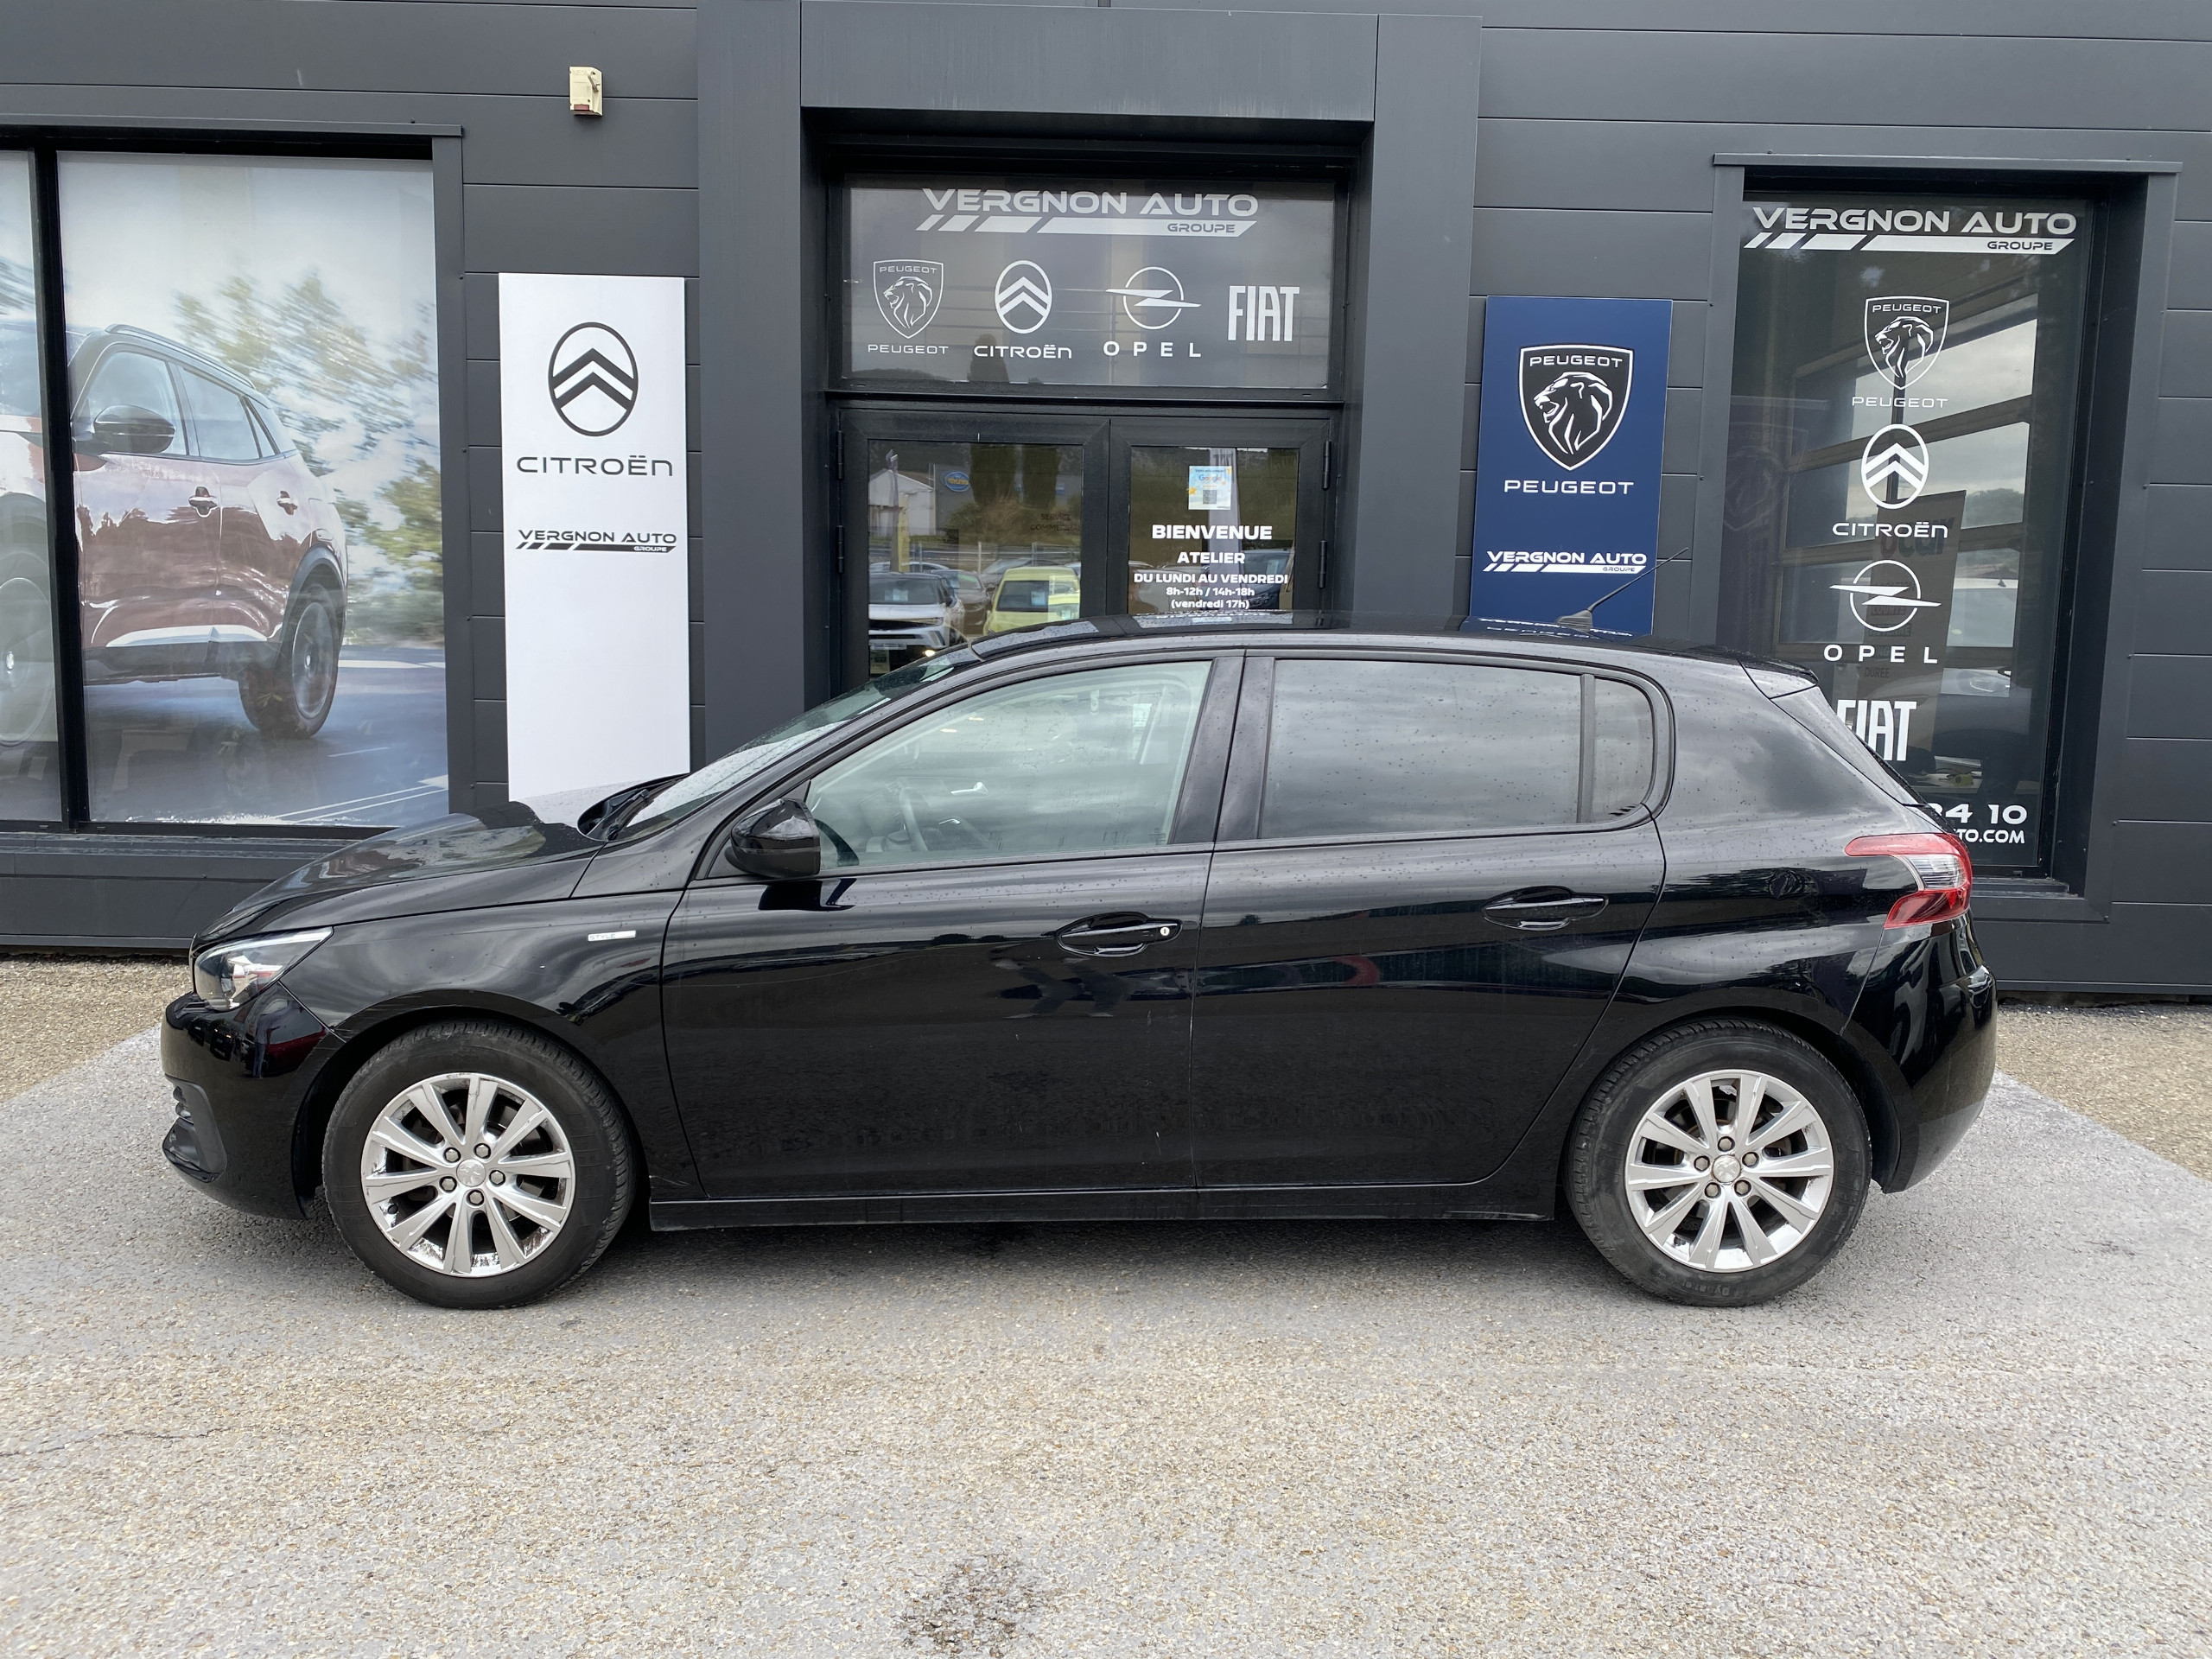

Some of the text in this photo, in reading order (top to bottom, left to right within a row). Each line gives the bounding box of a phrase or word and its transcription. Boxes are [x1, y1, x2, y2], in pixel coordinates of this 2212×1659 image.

[922, 188, 1259, 217] VERGNON AUTO
[1166, 223, 1236, 233] GROUPE
[1752, 207, 2077, 235] VERGNON AUTO
[1986, 240, 2053, 251] GROUPE
[879, 265, 938, 275] PEUGEOT
[1227, 285, 1300, 342] FIAT
[1872, 303, 1942, 314] PEUGEOT
[868, 344, 949, 354] PEUGEOT
[973, 344, 1072, 359] CITROËN
[1103, 340, 1202, 358] OPEL
[1529, 354, 1623, 368] PEUGEOT
[1852, 396, 1948, 409] PEUGEOT
[516, 454, 673, 477] CITROËN
[1503, 480, 1635, 495] PEUGEOT
[518, 529, 677, 544] VERGNON AUTO
[1152, 524, 1273, 540] BIENVENUE
[1832, 521, 1948, 539] CITROËN
[1176, 551, 1246, 565] ATELIER
[1486, 550, 1648, 565] VERGNON AUTO
[1134, 573, 1288, 585] DU LUNDI AU VENDREDI
[1166, 587, 1255, 596] 8h-12h / 14h-18h
[1171, 599, 1250, 609] (vendredi 17h)
[1823, 644, 1938, 664] OPEL
[1987, 804, 2028, 825] 10
[1954, 829, 2025, 844] TO.COM
